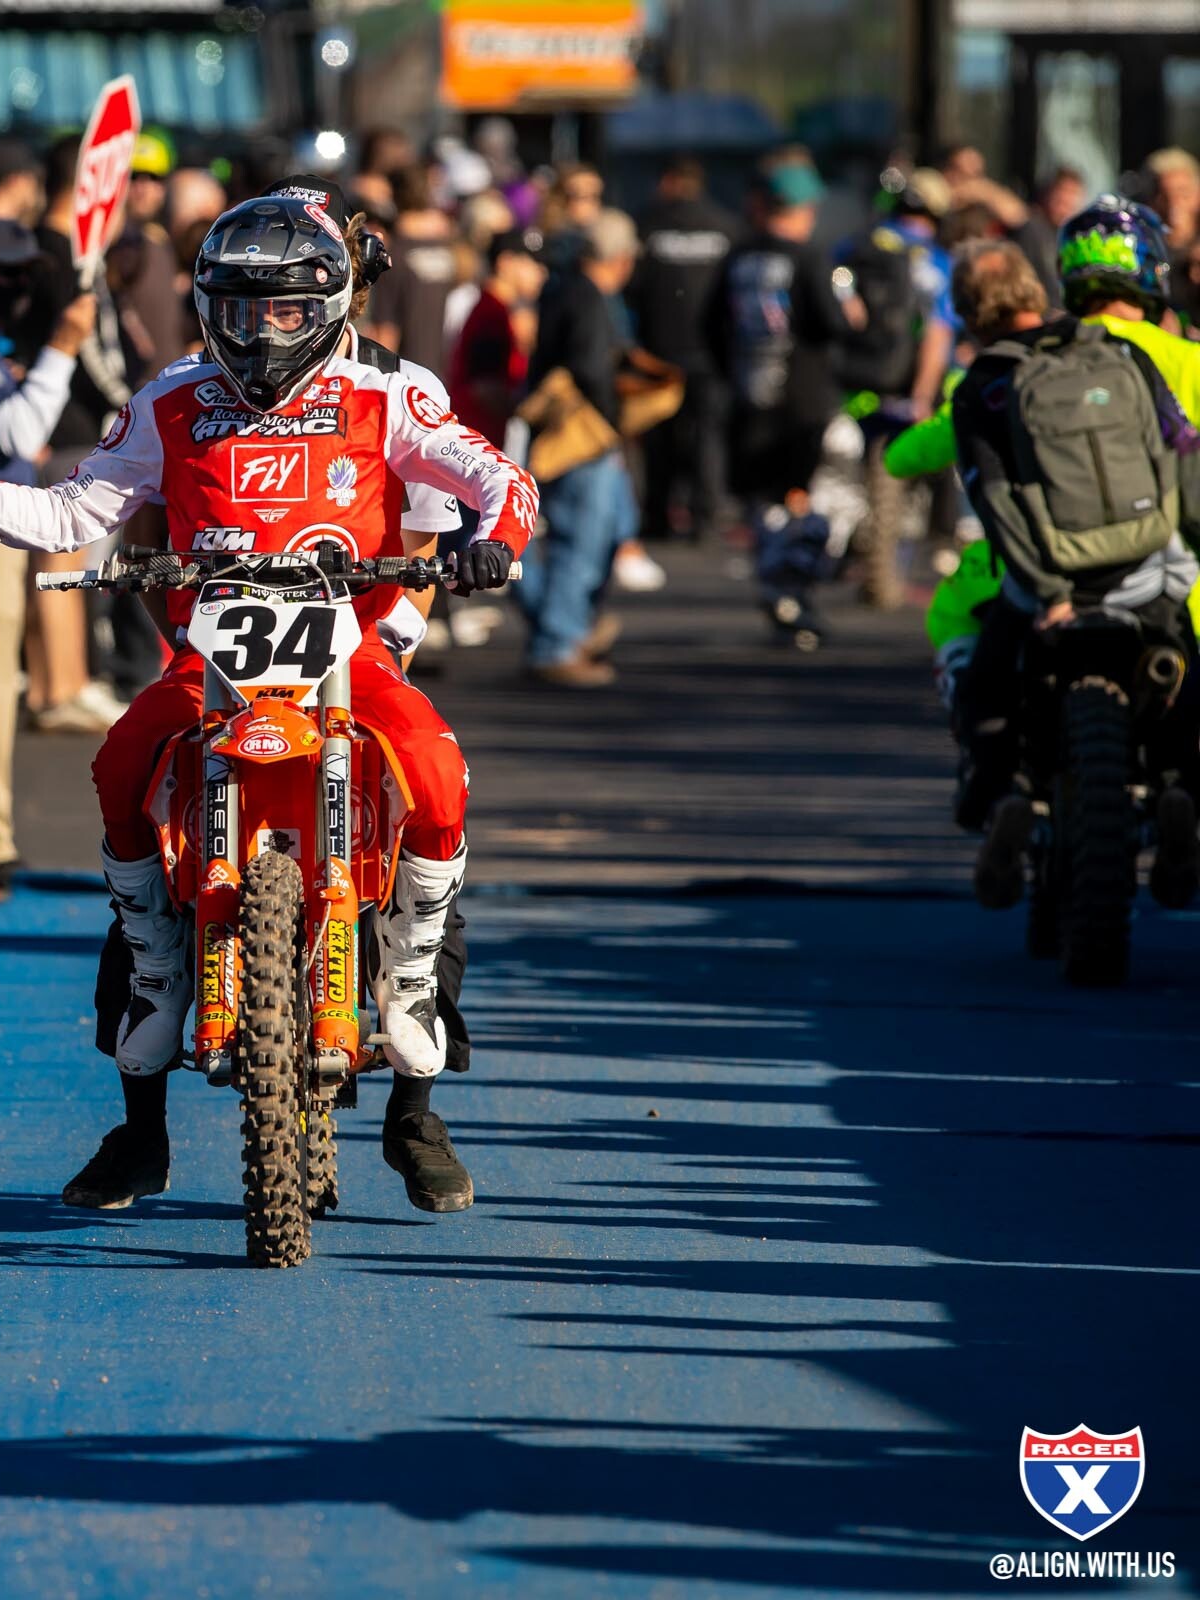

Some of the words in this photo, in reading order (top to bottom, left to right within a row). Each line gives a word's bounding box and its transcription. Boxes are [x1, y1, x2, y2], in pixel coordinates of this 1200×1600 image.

[211, 408, 259, 422] ROCKY
[440, 441, 477, 467] SWEET
[239, 453, 300, 492] FLY
[192, 527, 255, 551] KTM
[252, 589, 308, 599] MONSTER
[212, 606, 337, 681] 34
[256, 687, 294, 699] KTM
[249, 739, 279, 750] RM
[328, 919, 346, 1003] GALFER
